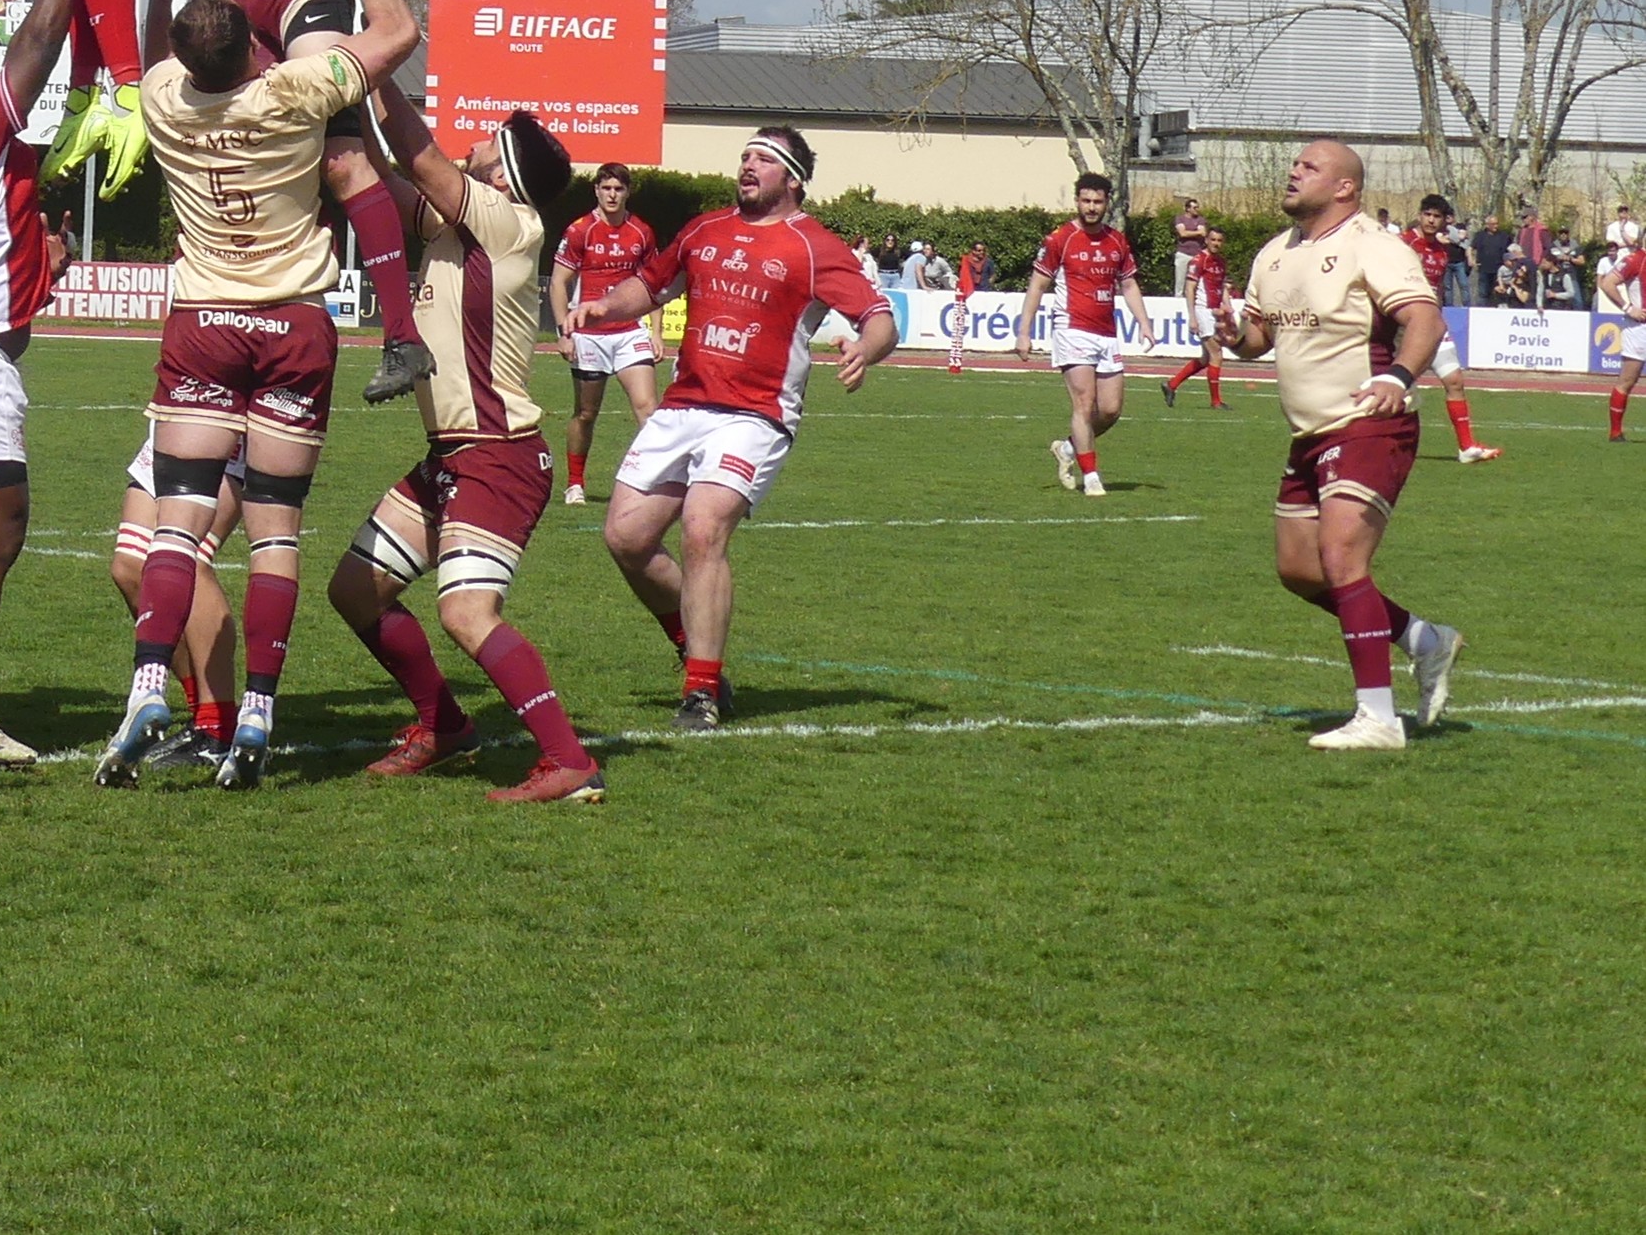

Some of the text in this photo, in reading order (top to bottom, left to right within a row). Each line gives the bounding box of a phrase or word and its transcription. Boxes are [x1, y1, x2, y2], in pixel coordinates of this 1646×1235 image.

[509, 16, 618, 40] EIFFAGE
[510, 43, 544, 54] ROUTE
[455, 96, 640, 117] Aménagez vos espaces
[454, 116, 621, 135] de de loisirs
[205, 129, 263, 150] MSC
[208, 166, 256, 225] 5
[96, 266, 166, 293] VISION
[198, 310, 290, 334] Dalloyeau
[1510, 315, 1549, 328] Auch
[1508, 334, 1550, 347] Pavie
[1494, 352, 1563, 368] Preignan
